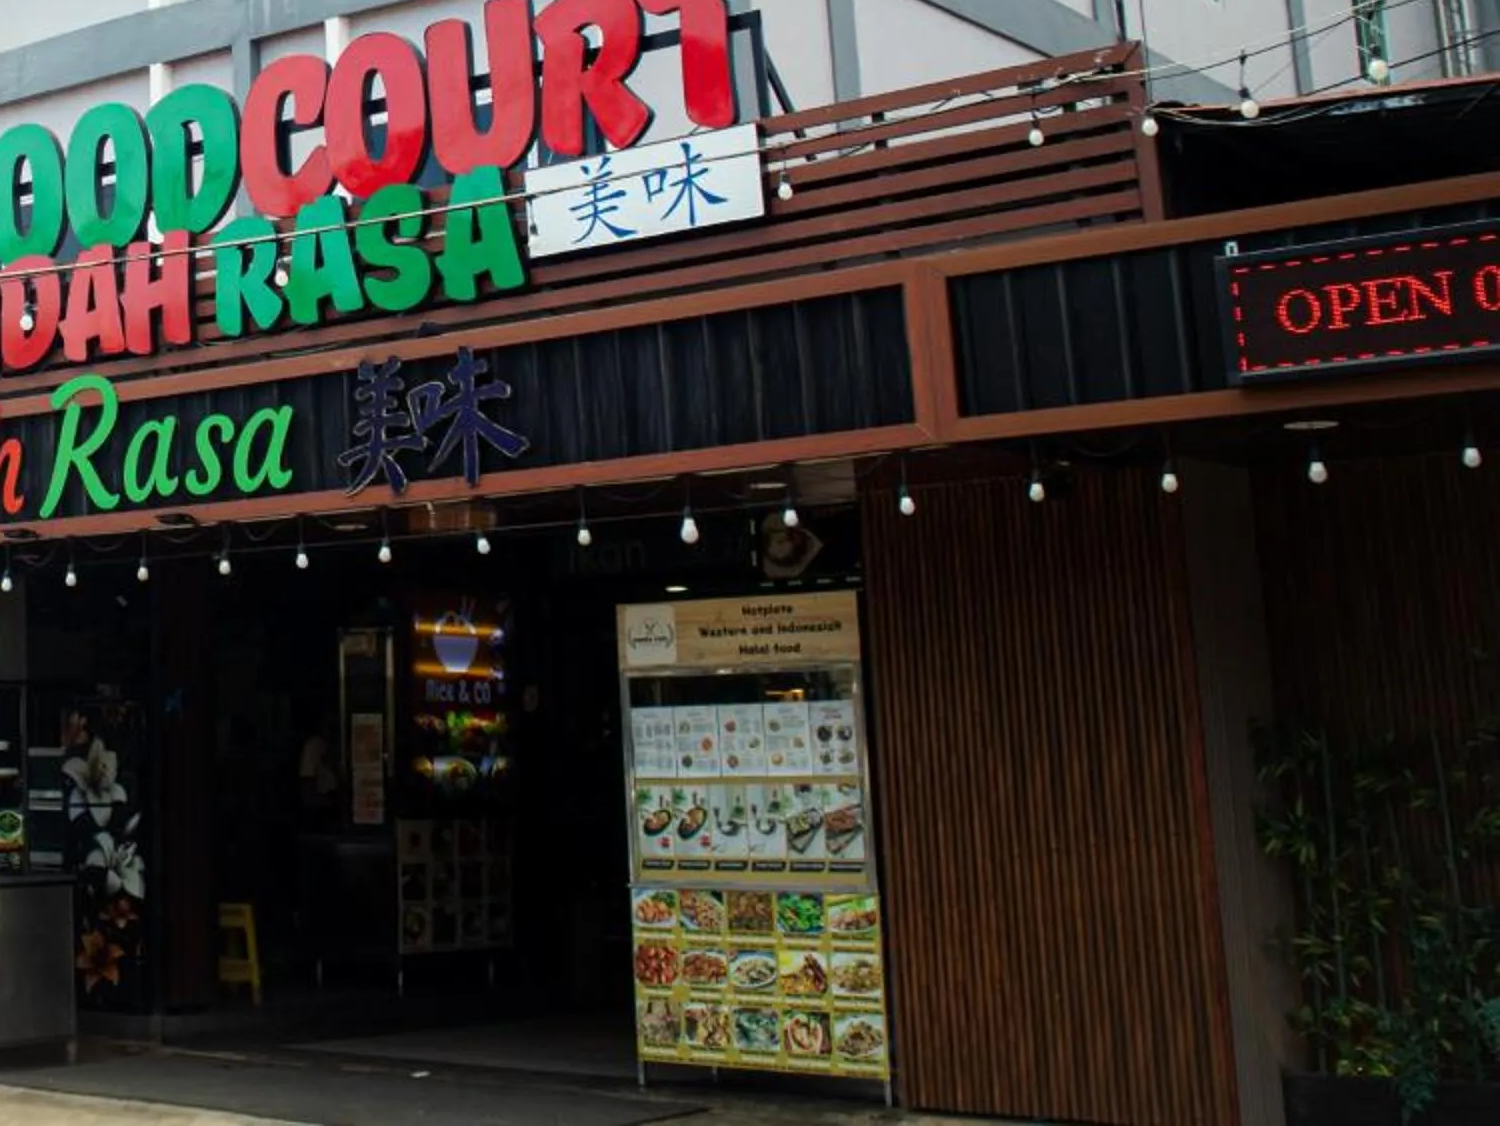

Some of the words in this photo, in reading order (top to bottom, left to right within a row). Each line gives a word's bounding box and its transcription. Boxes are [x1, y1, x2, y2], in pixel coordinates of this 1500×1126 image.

[215, 166, 530, 338] RASA
[569, 142, 729, 244] 美味
[1276, 271, 1453, 334] OPEN
[38, 375, 295, 520] Rasa
[337, 346, 530, 496] 美味
[751, 623, 774, 636] and
